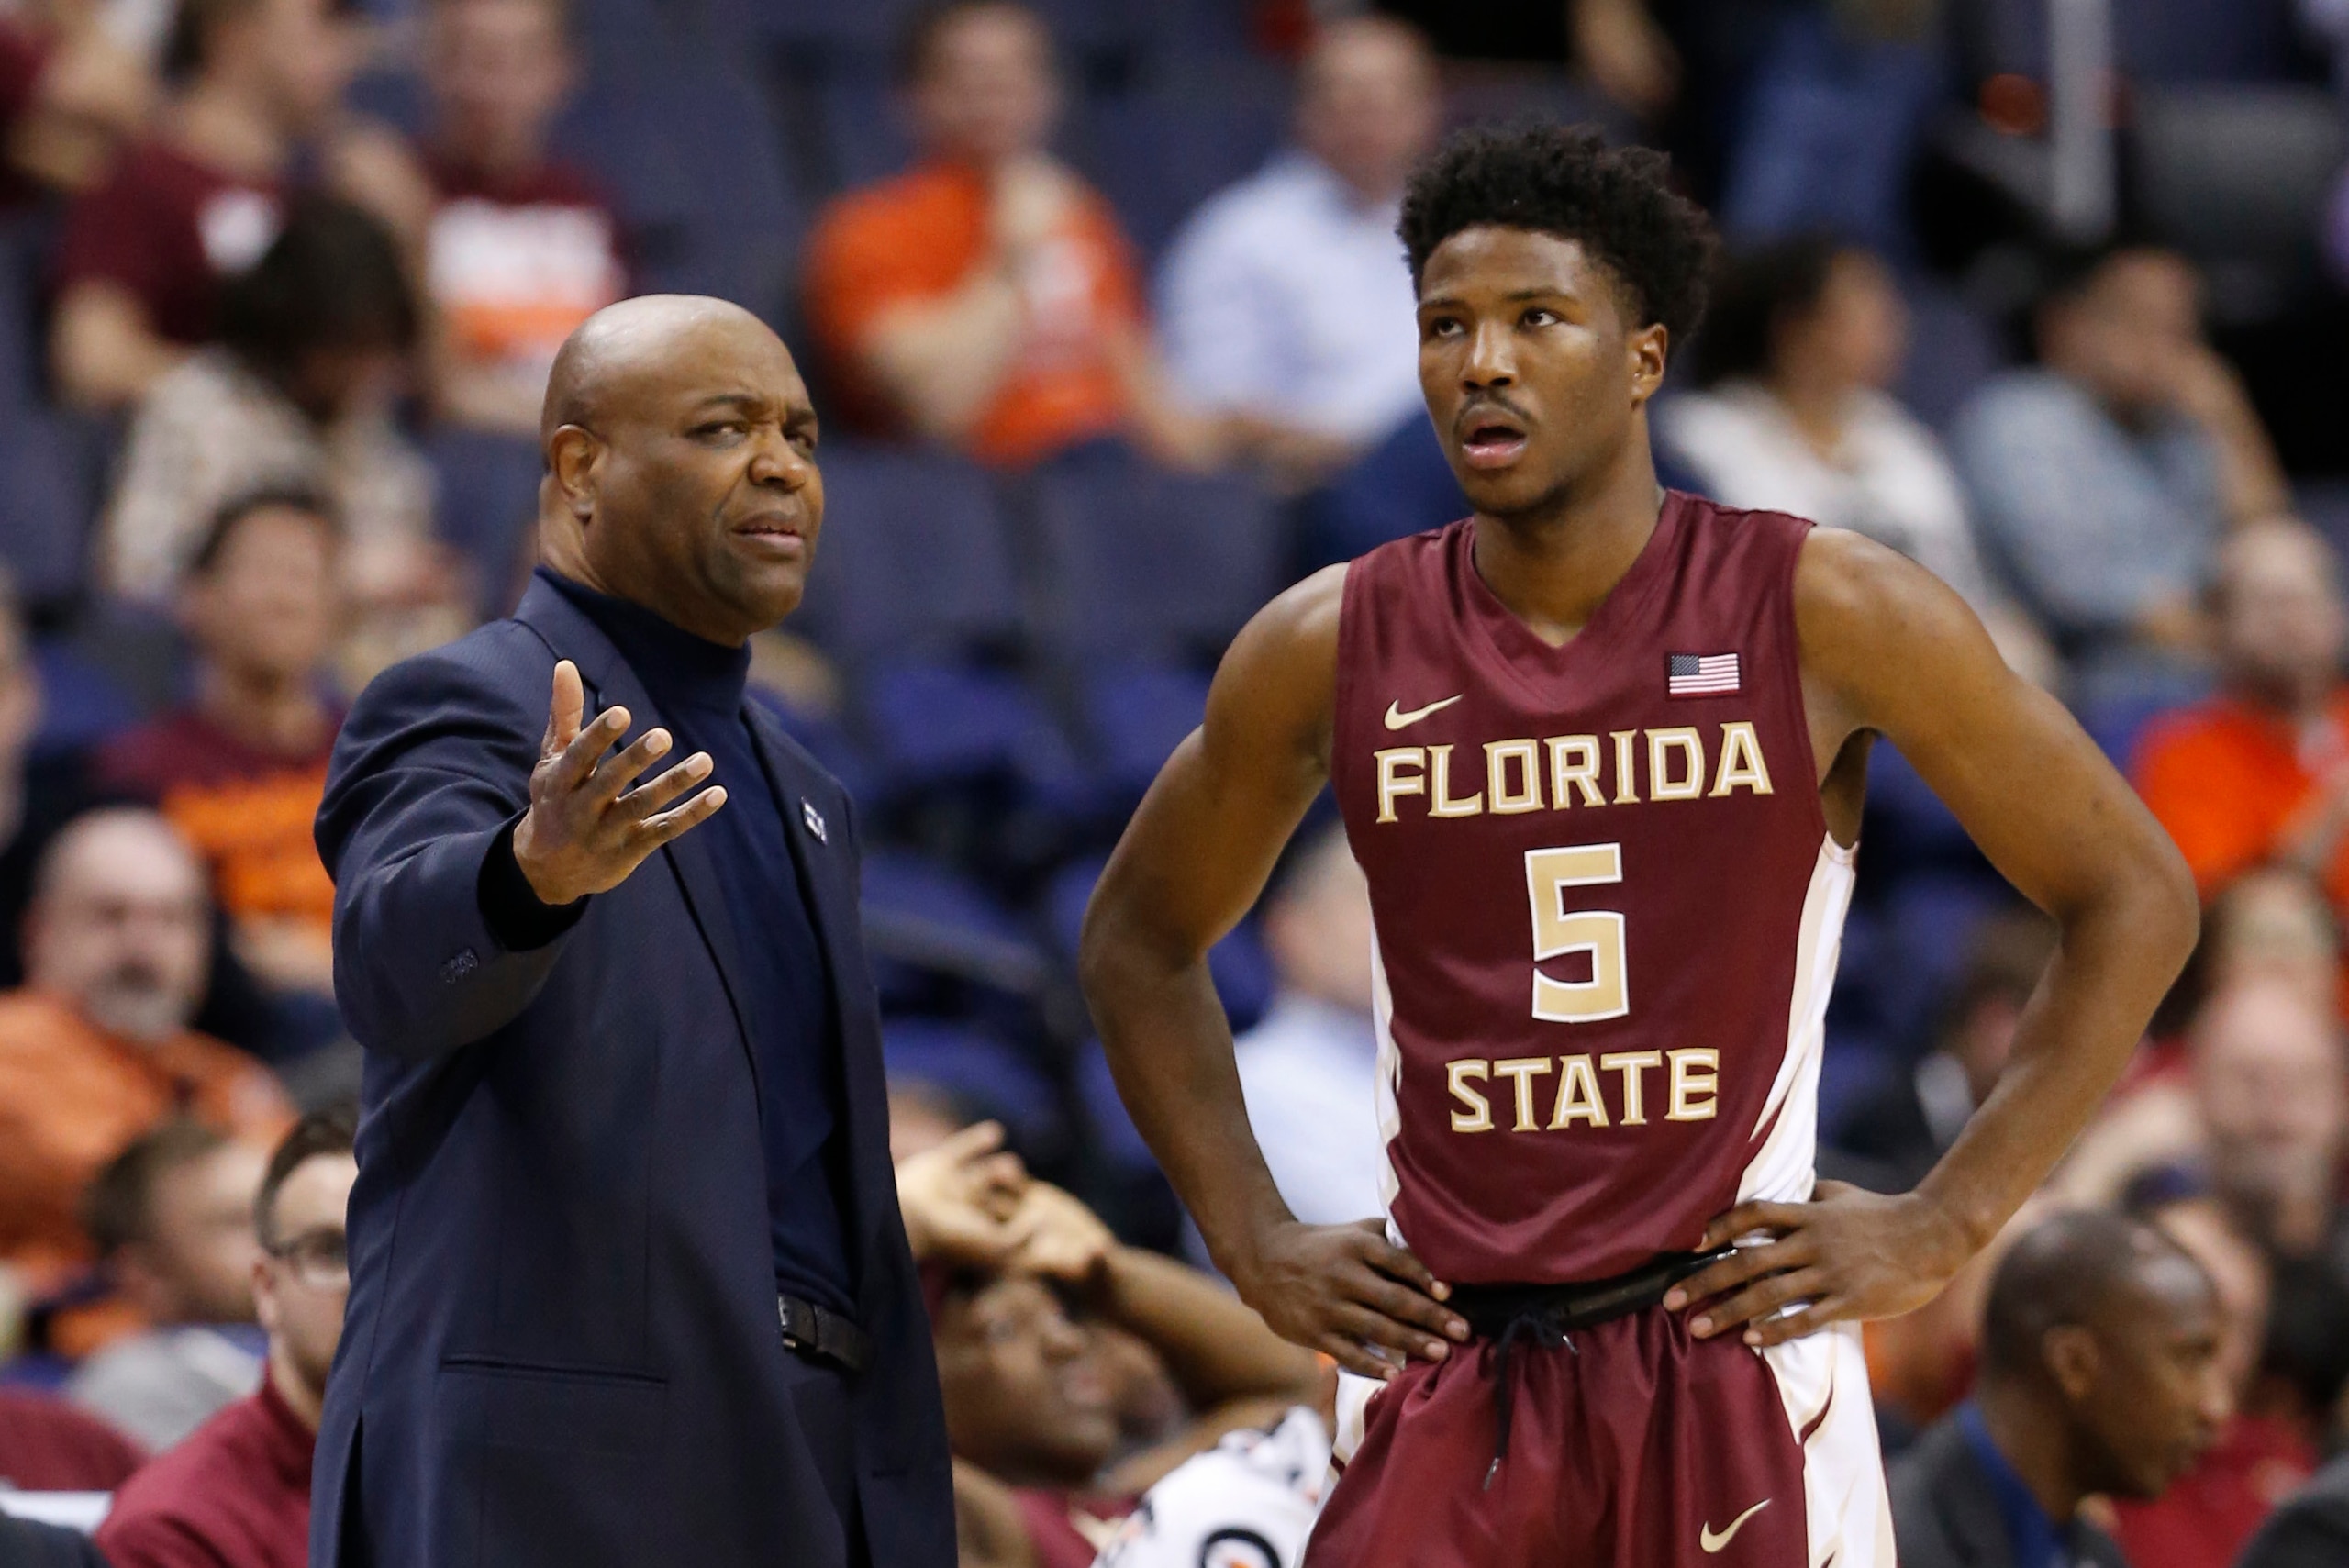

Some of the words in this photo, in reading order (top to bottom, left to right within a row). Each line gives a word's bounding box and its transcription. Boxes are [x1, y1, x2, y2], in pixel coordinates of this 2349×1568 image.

[1373, 721, 1774, 823] FLORIDA
[1524, 842, 1630, 1024] 5
[1445, 1047, 1720, 1133] STATE
